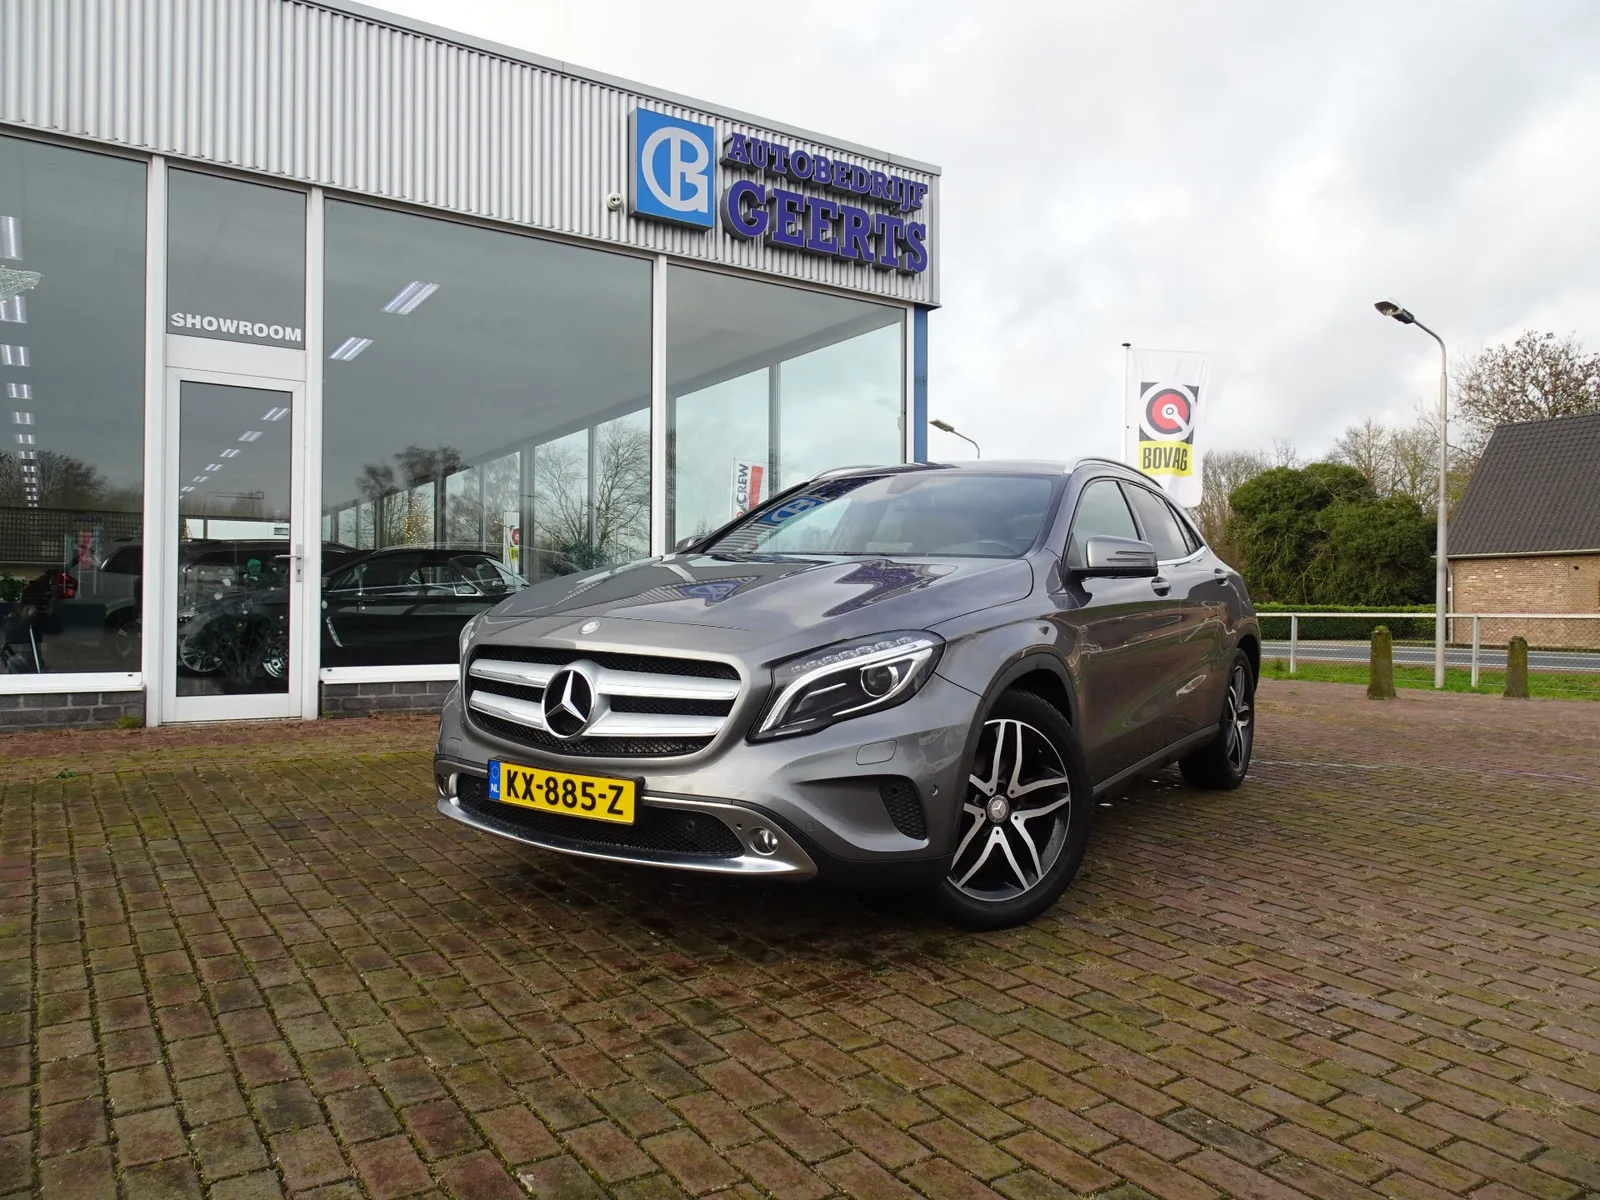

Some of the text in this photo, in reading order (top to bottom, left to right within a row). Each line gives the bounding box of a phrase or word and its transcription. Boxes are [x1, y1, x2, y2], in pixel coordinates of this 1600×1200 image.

[727, 132, 929, 213] AUTOBEDRIJF
[727, 179, 929, 274] GEERTS
[170, 312, 302, 342] SHOWROOM
[1142, 446, 1188, 471] BOVAG
[490, 782, 500, 794] NL
[506, 769, 624, 816] KX-885-Z
